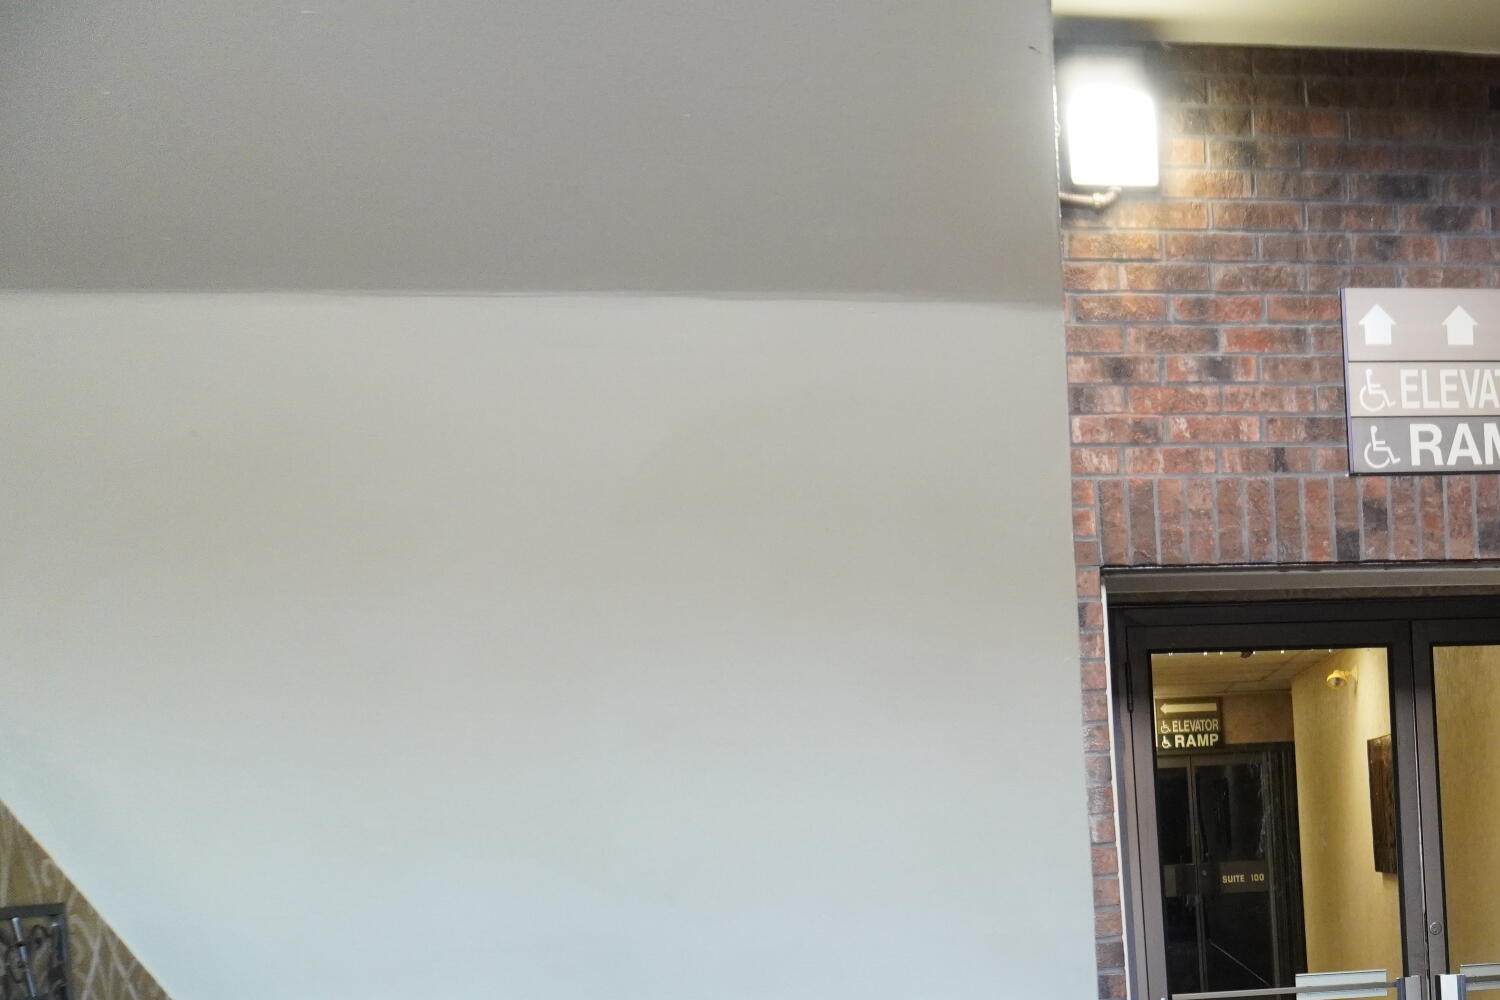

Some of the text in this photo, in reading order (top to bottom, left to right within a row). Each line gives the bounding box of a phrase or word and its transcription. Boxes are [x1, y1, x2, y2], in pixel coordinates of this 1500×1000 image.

[1172, 719, 1219, 733] ELEVATOR
[1174, 733, 1219, 748] RAMP
[1222, 873, 1265, 884] SUITE 100
